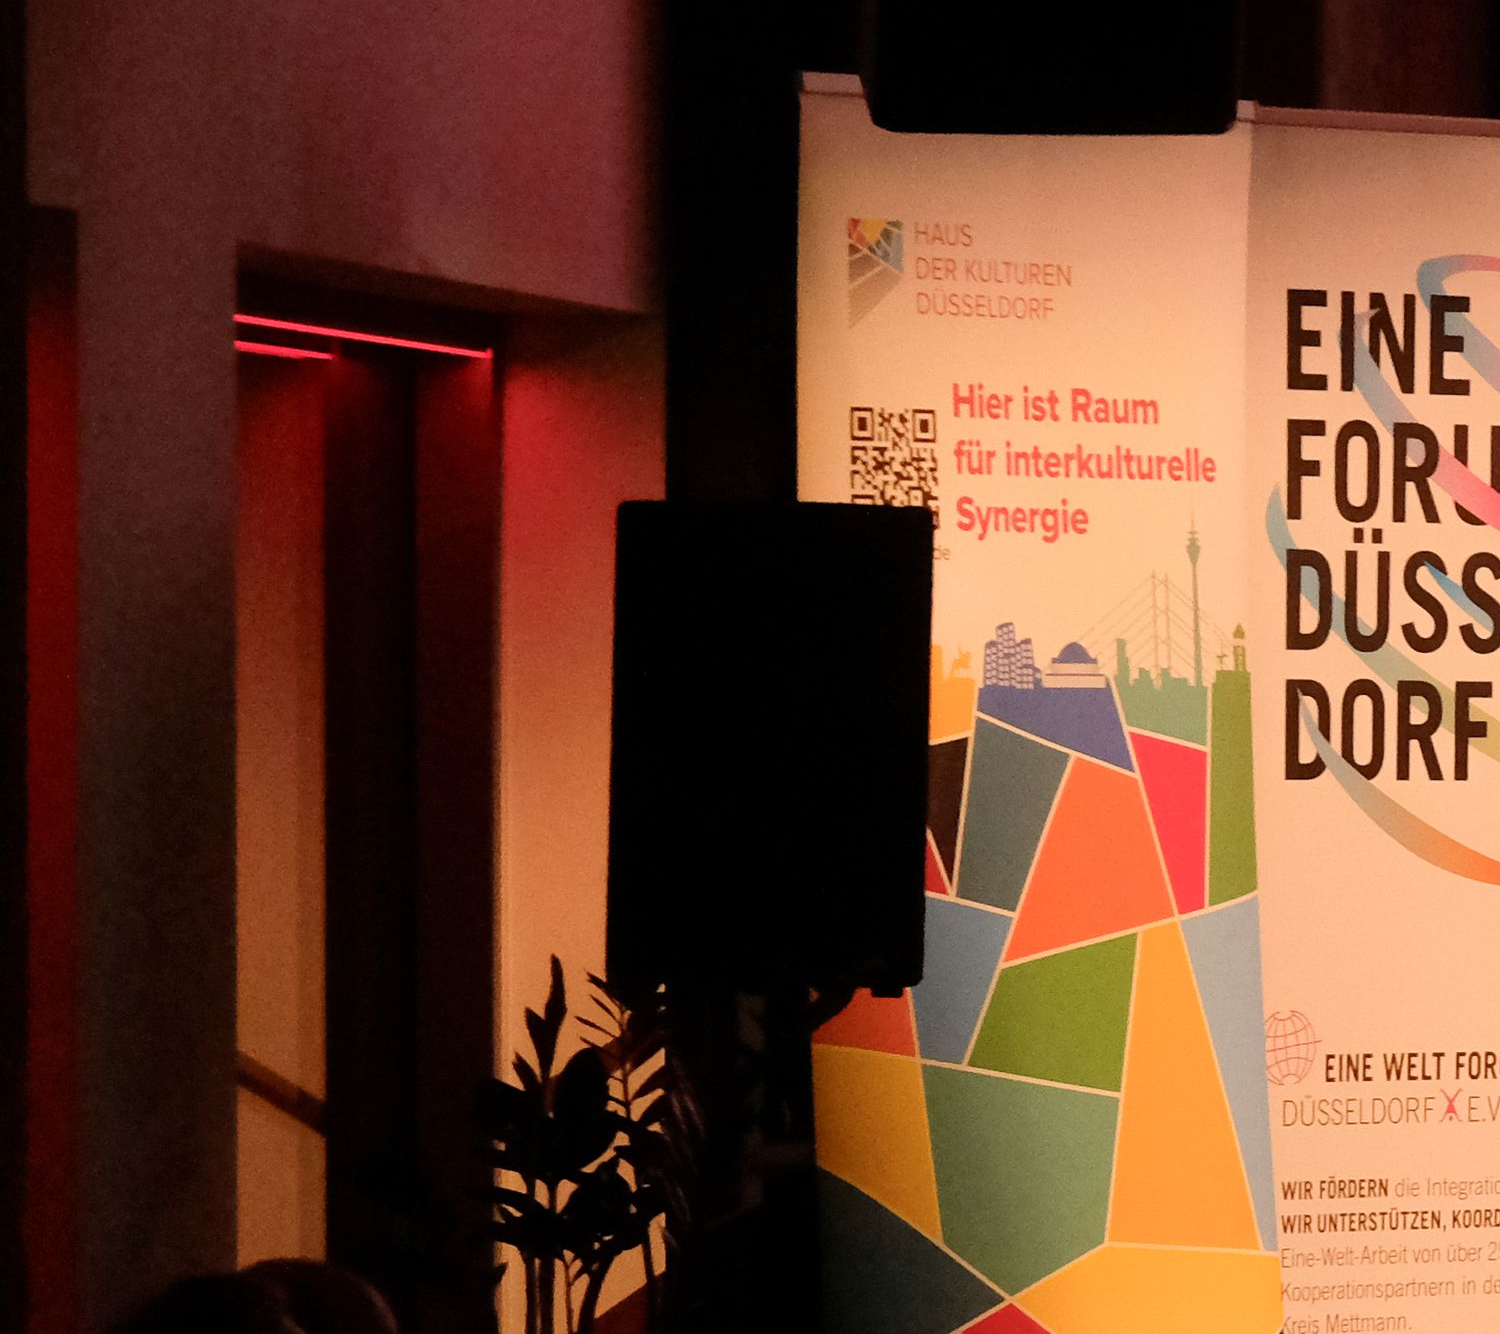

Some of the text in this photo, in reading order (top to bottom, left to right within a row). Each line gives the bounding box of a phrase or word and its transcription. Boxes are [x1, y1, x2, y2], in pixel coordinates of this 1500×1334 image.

[914, 222, 973, 248] HAUS
[915, 256, 1073, 287] DER KULTUREN
[916, 287, 1055, 320] DÜSSELDORF
[1286, 288, 1471, 397] EINE
[952, 383, 1159, 425] Hier ist Raum
[953, 440, 1216, 483] für interkulturelle
[956, 496, 1089, 543] Synergie
[1284, 678, 1493, 781] DORF
[1325, 1053, 1373, 1083] EINE
[1383, 1052, 1445, 1082] WELT
[1282, 1095, 1435, 1127] DÜSSELDORF
[1281, 1180, 1313, 1200] WIR
[1319, 1176, 1389, 1200] FÖRDERN
[1394, 1179, 1420, 1197] die
[1281, 1214, 1312, 1234] WIR
[1317, 1208, 1447, 1233] UNTERSTÜTZEN,
[1281, 1245, 1408, 1268] Eine-Welt-Arbeit
[1411, 1248, 1440, 1264] von
[1447, 1244, 1483, 1263] über
[1282, 1279, 1455, 1303] Kooperationspartnern
[1462, 1276, 1476, 1295] in
[1325, 1313, 1412, 1334] Mettmann.
